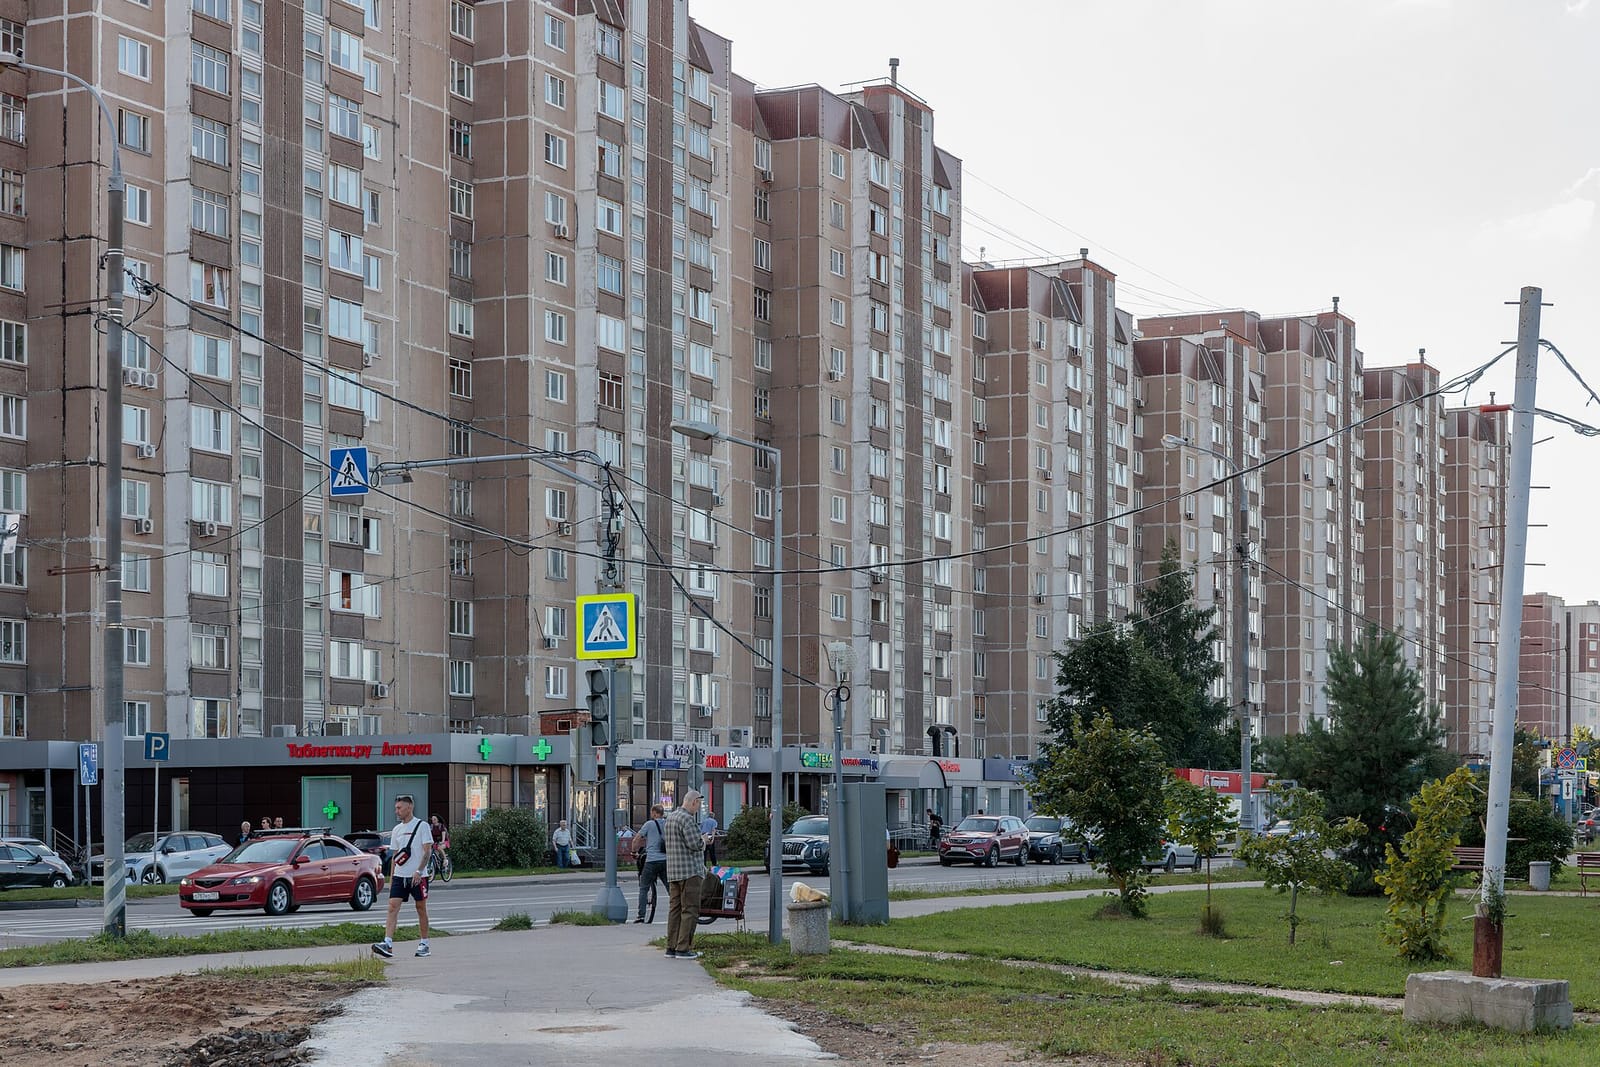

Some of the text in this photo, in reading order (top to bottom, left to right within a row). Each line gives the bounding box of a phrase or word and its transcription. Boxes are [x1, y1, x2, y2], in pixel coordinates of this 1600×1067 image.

[151, 736, 165, 758] P
[286, 741, 432, 759] Таблетка.ру Аптека
